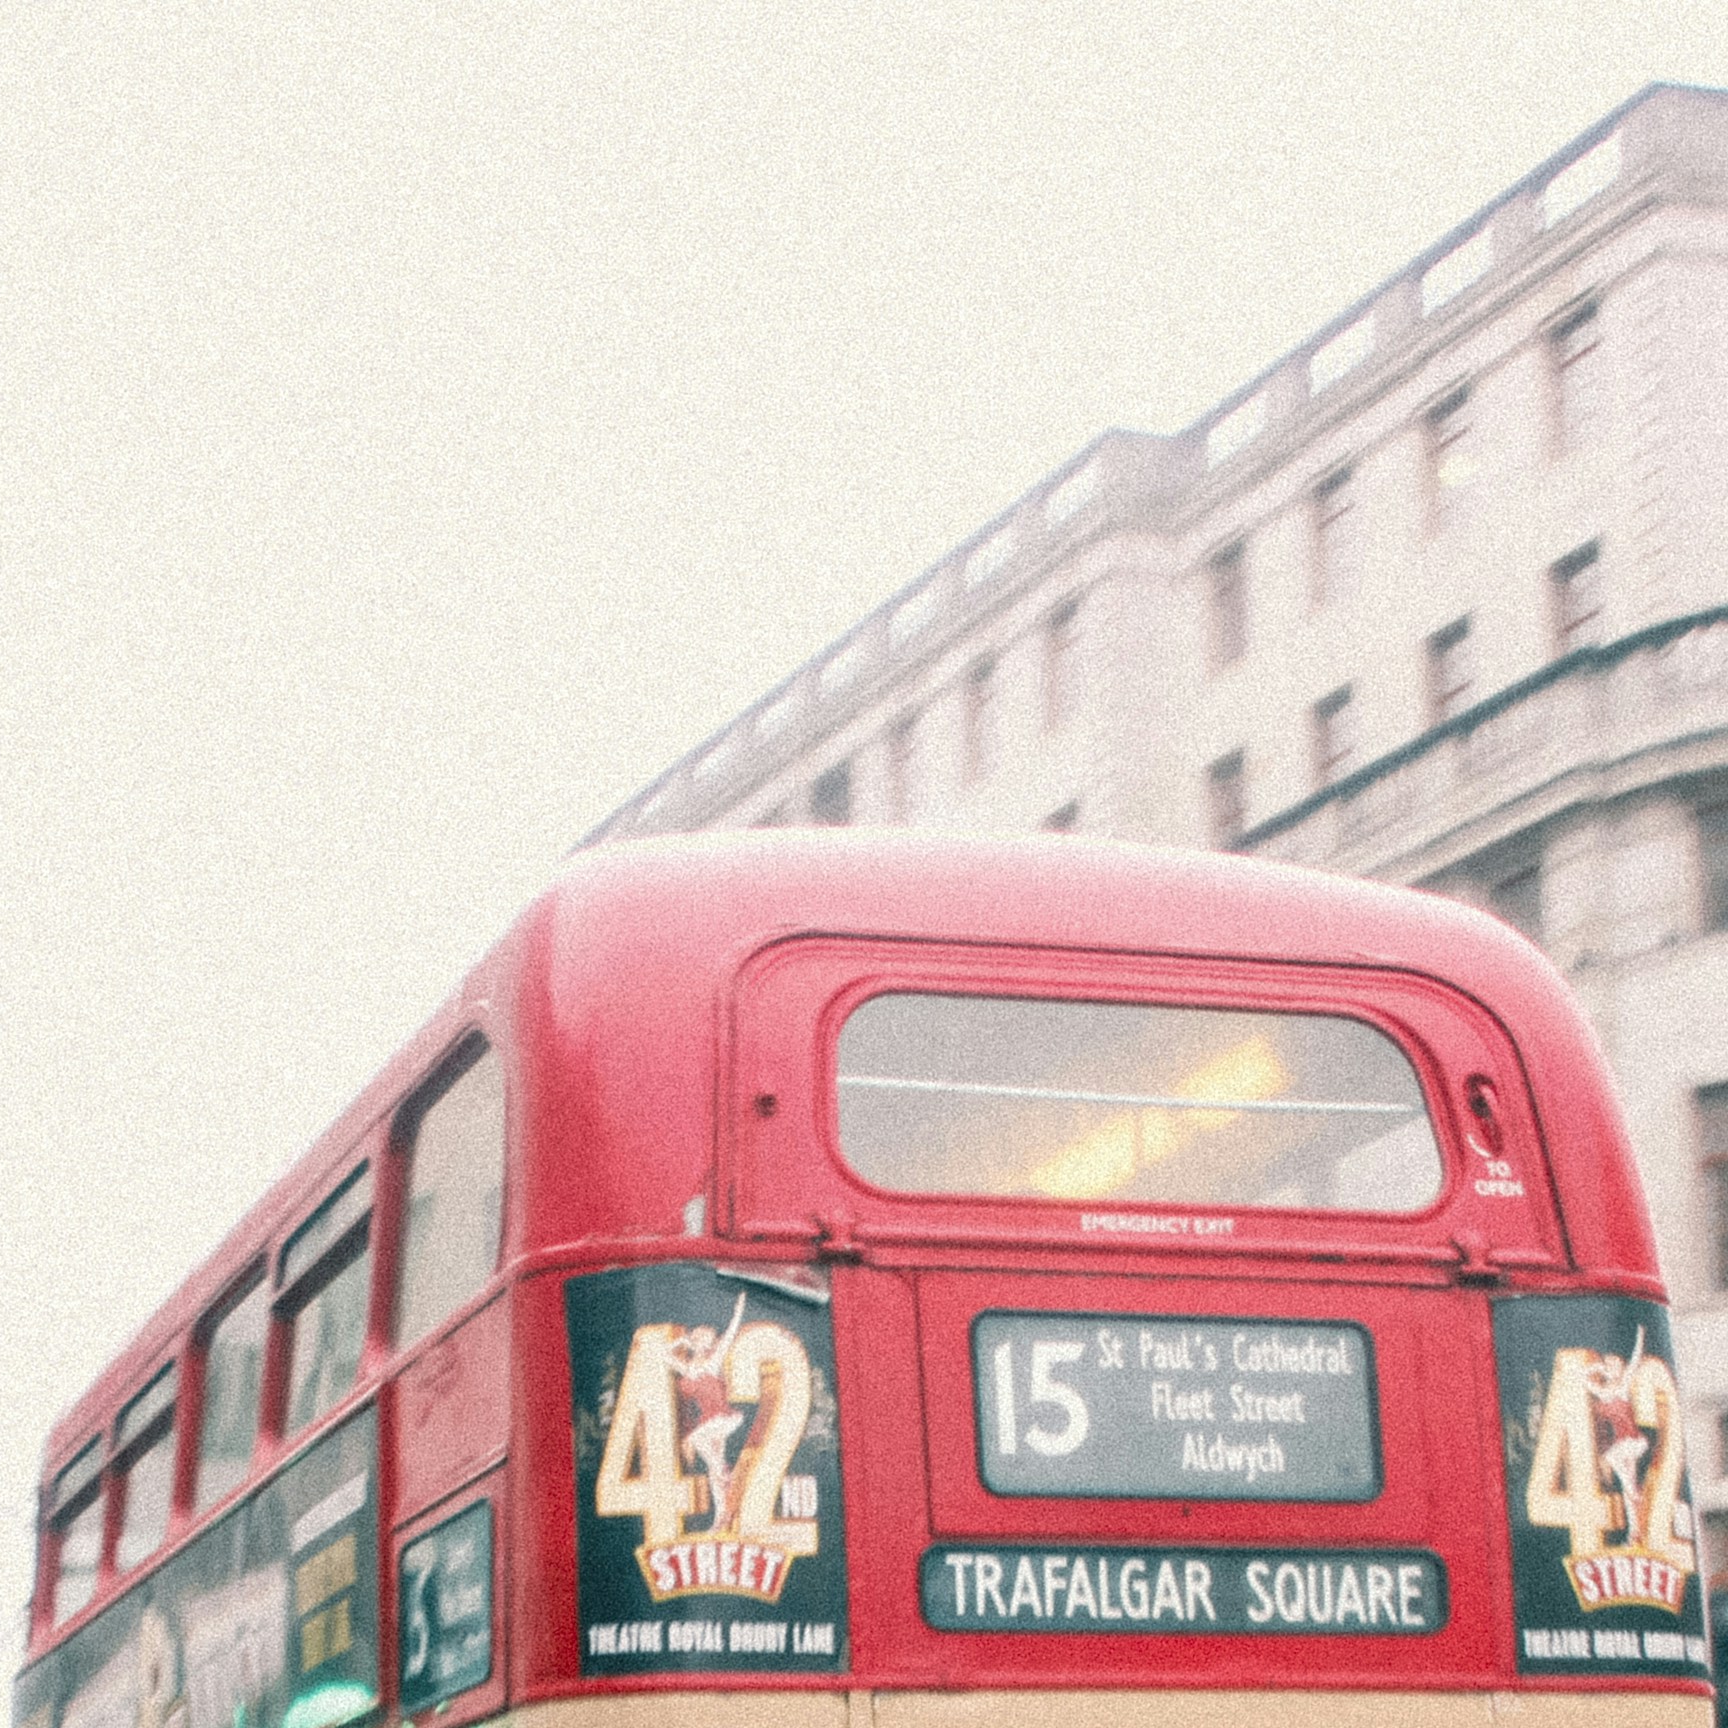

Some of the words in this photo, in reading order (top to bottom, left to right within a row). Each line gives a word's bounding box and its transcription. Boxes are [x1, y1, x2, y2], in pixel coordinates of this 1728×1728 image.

[1474, 1179, 1524, 1197] OPEN
[1485, 1161, 1511, 1178] TO
[1080, 1213, 1189, 1235] EMERGENCY
[1194, 1217, 1235, 1235] EXIT
[1098, 1329, 1124, 1368] St
[1139, 1331, 1217, 1372] Paul's
[1232, 1332, 1353, 1375] Cathedral
[993, 1339, 1091, 1456] 15
[1151, 1382, 1216, 1422] Fleet
[1231, 1385, 1306, 1424] Street
[1181, 1434, 1285, 1482] Aldwych
[648, 1543, 788, 1594] STREET
[945, 1553, 1216, 1623] TRAFALGAR
[1246, 1560, 1425, 1626] SQUARE
[1574, 1554, 1681, 1605] STREET
[588, 1623, 663, 1655] THEATRE
[668, 1621, 722, 1652] ROYAL
[793, 1621, 835, 1654] LANE
